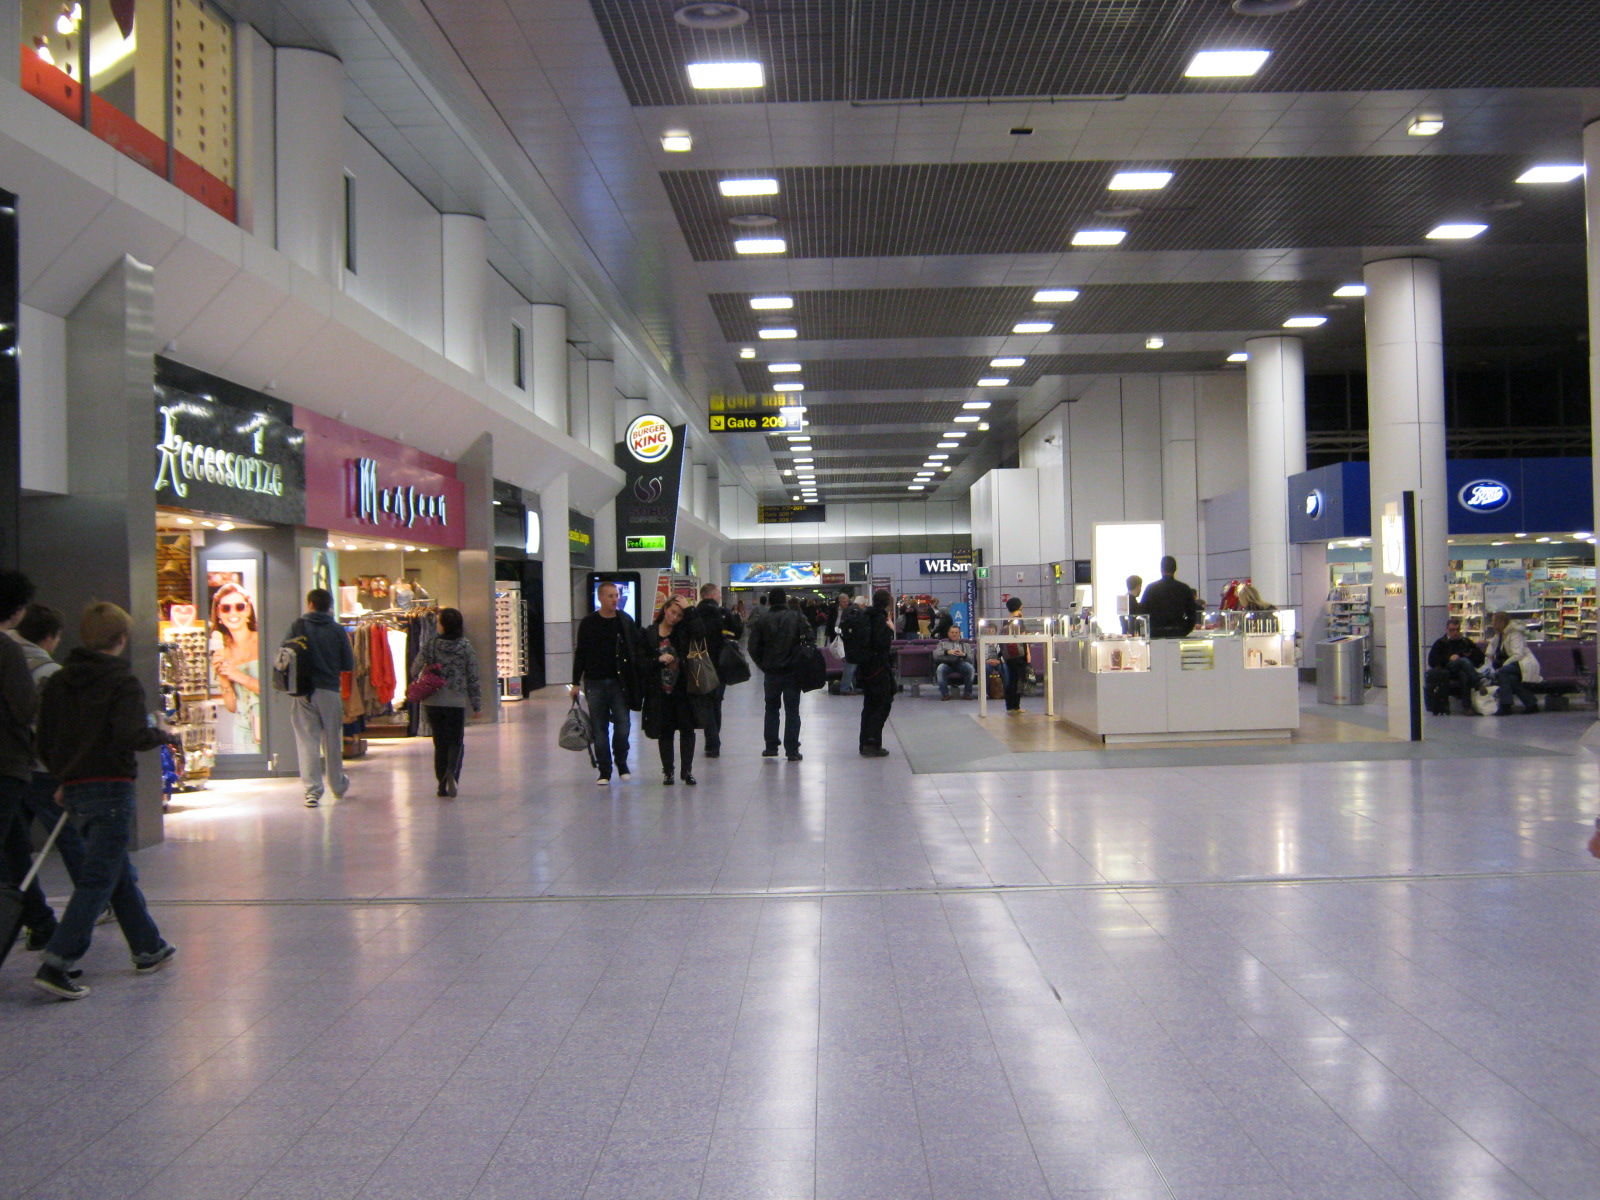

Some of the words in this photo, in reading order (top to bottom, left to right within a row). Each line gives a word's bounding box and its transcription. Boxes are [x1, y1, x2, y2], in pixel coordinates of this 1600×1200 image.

[632, 424, 665, 440] BURGER
[727, 417, 757, 428] Gate
[761, 416, 787, 428] 209
[633, 431, 667, 451] KING
[154, 405, 284, 498] Accessorize
[359, 456, 447, 529] Monsoon
[1467, 485, 1504, 505] Boots
